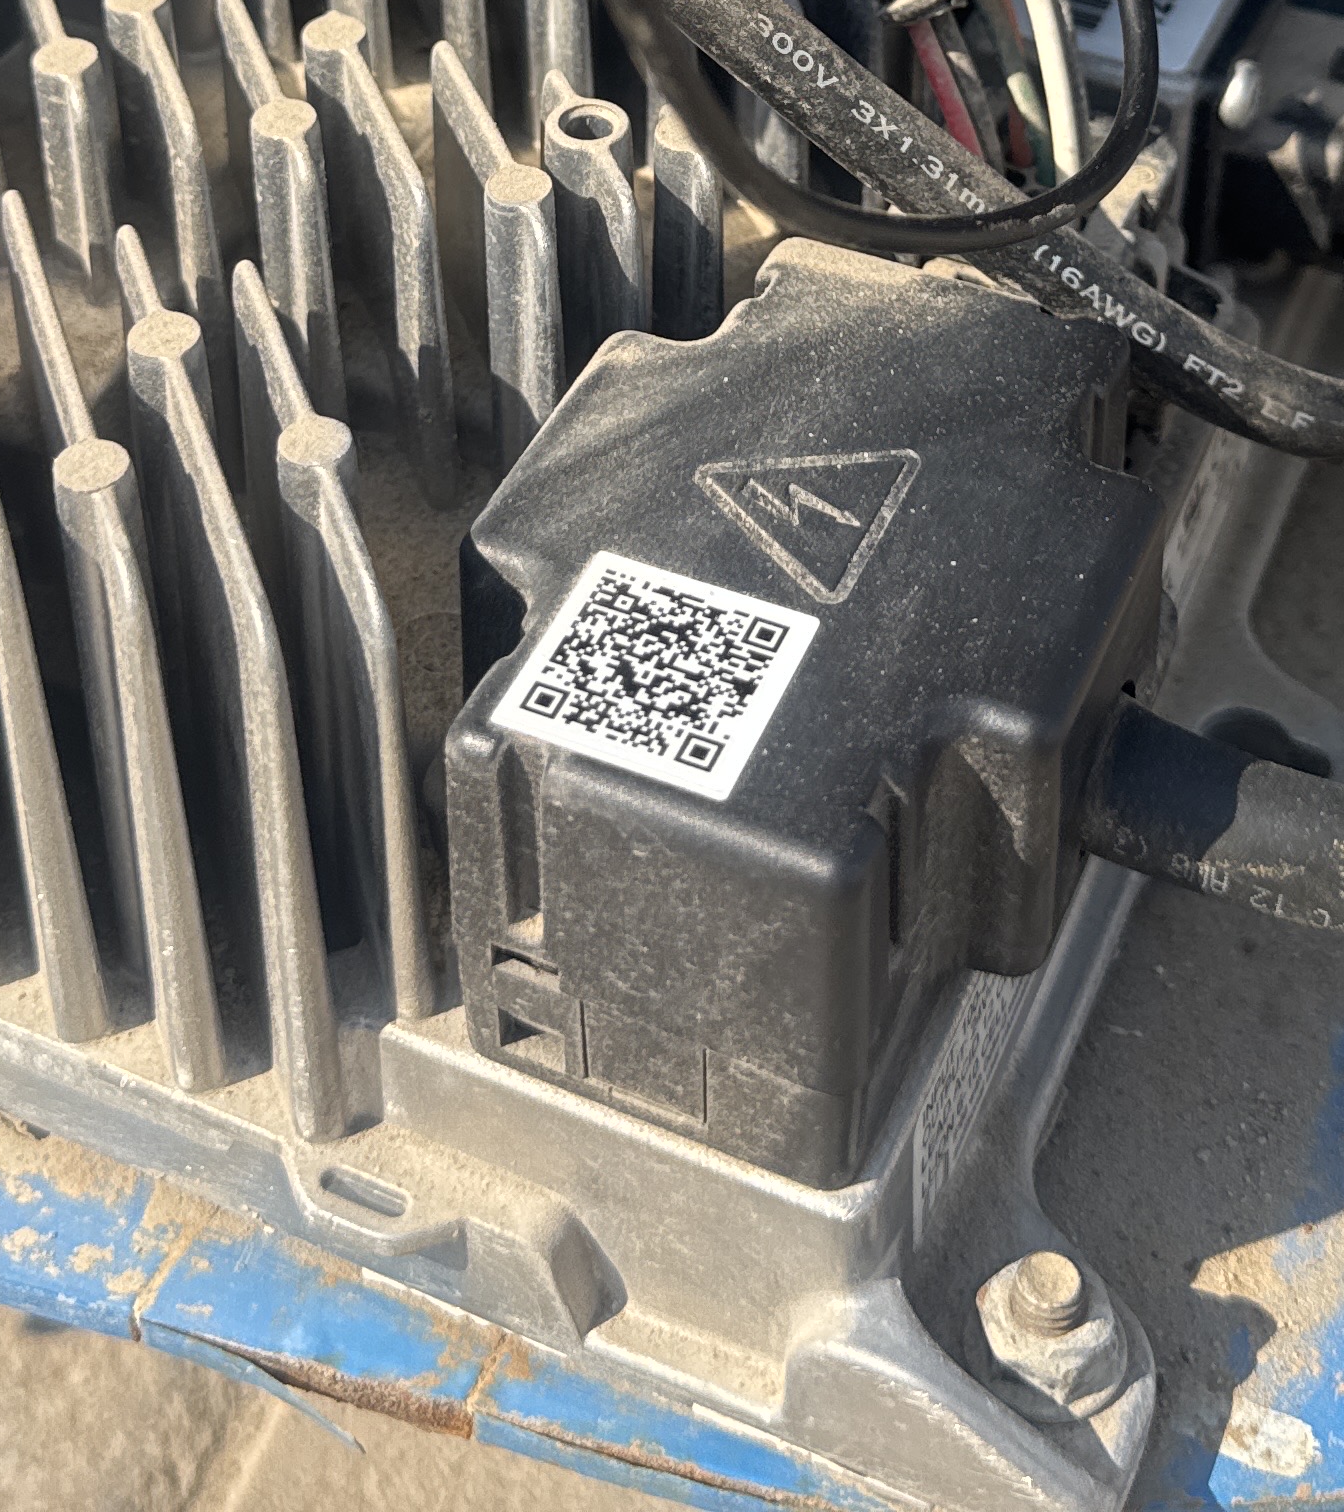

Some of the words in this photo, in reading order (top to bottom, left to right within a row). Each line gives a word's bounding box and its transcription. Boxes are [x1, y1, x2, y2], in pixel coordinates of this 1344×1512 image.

[753, 13, 839, 90] 300V
[1032, 243, 1168, 354] (16AWG)
[1181, 352, 1246, 402] FT2
